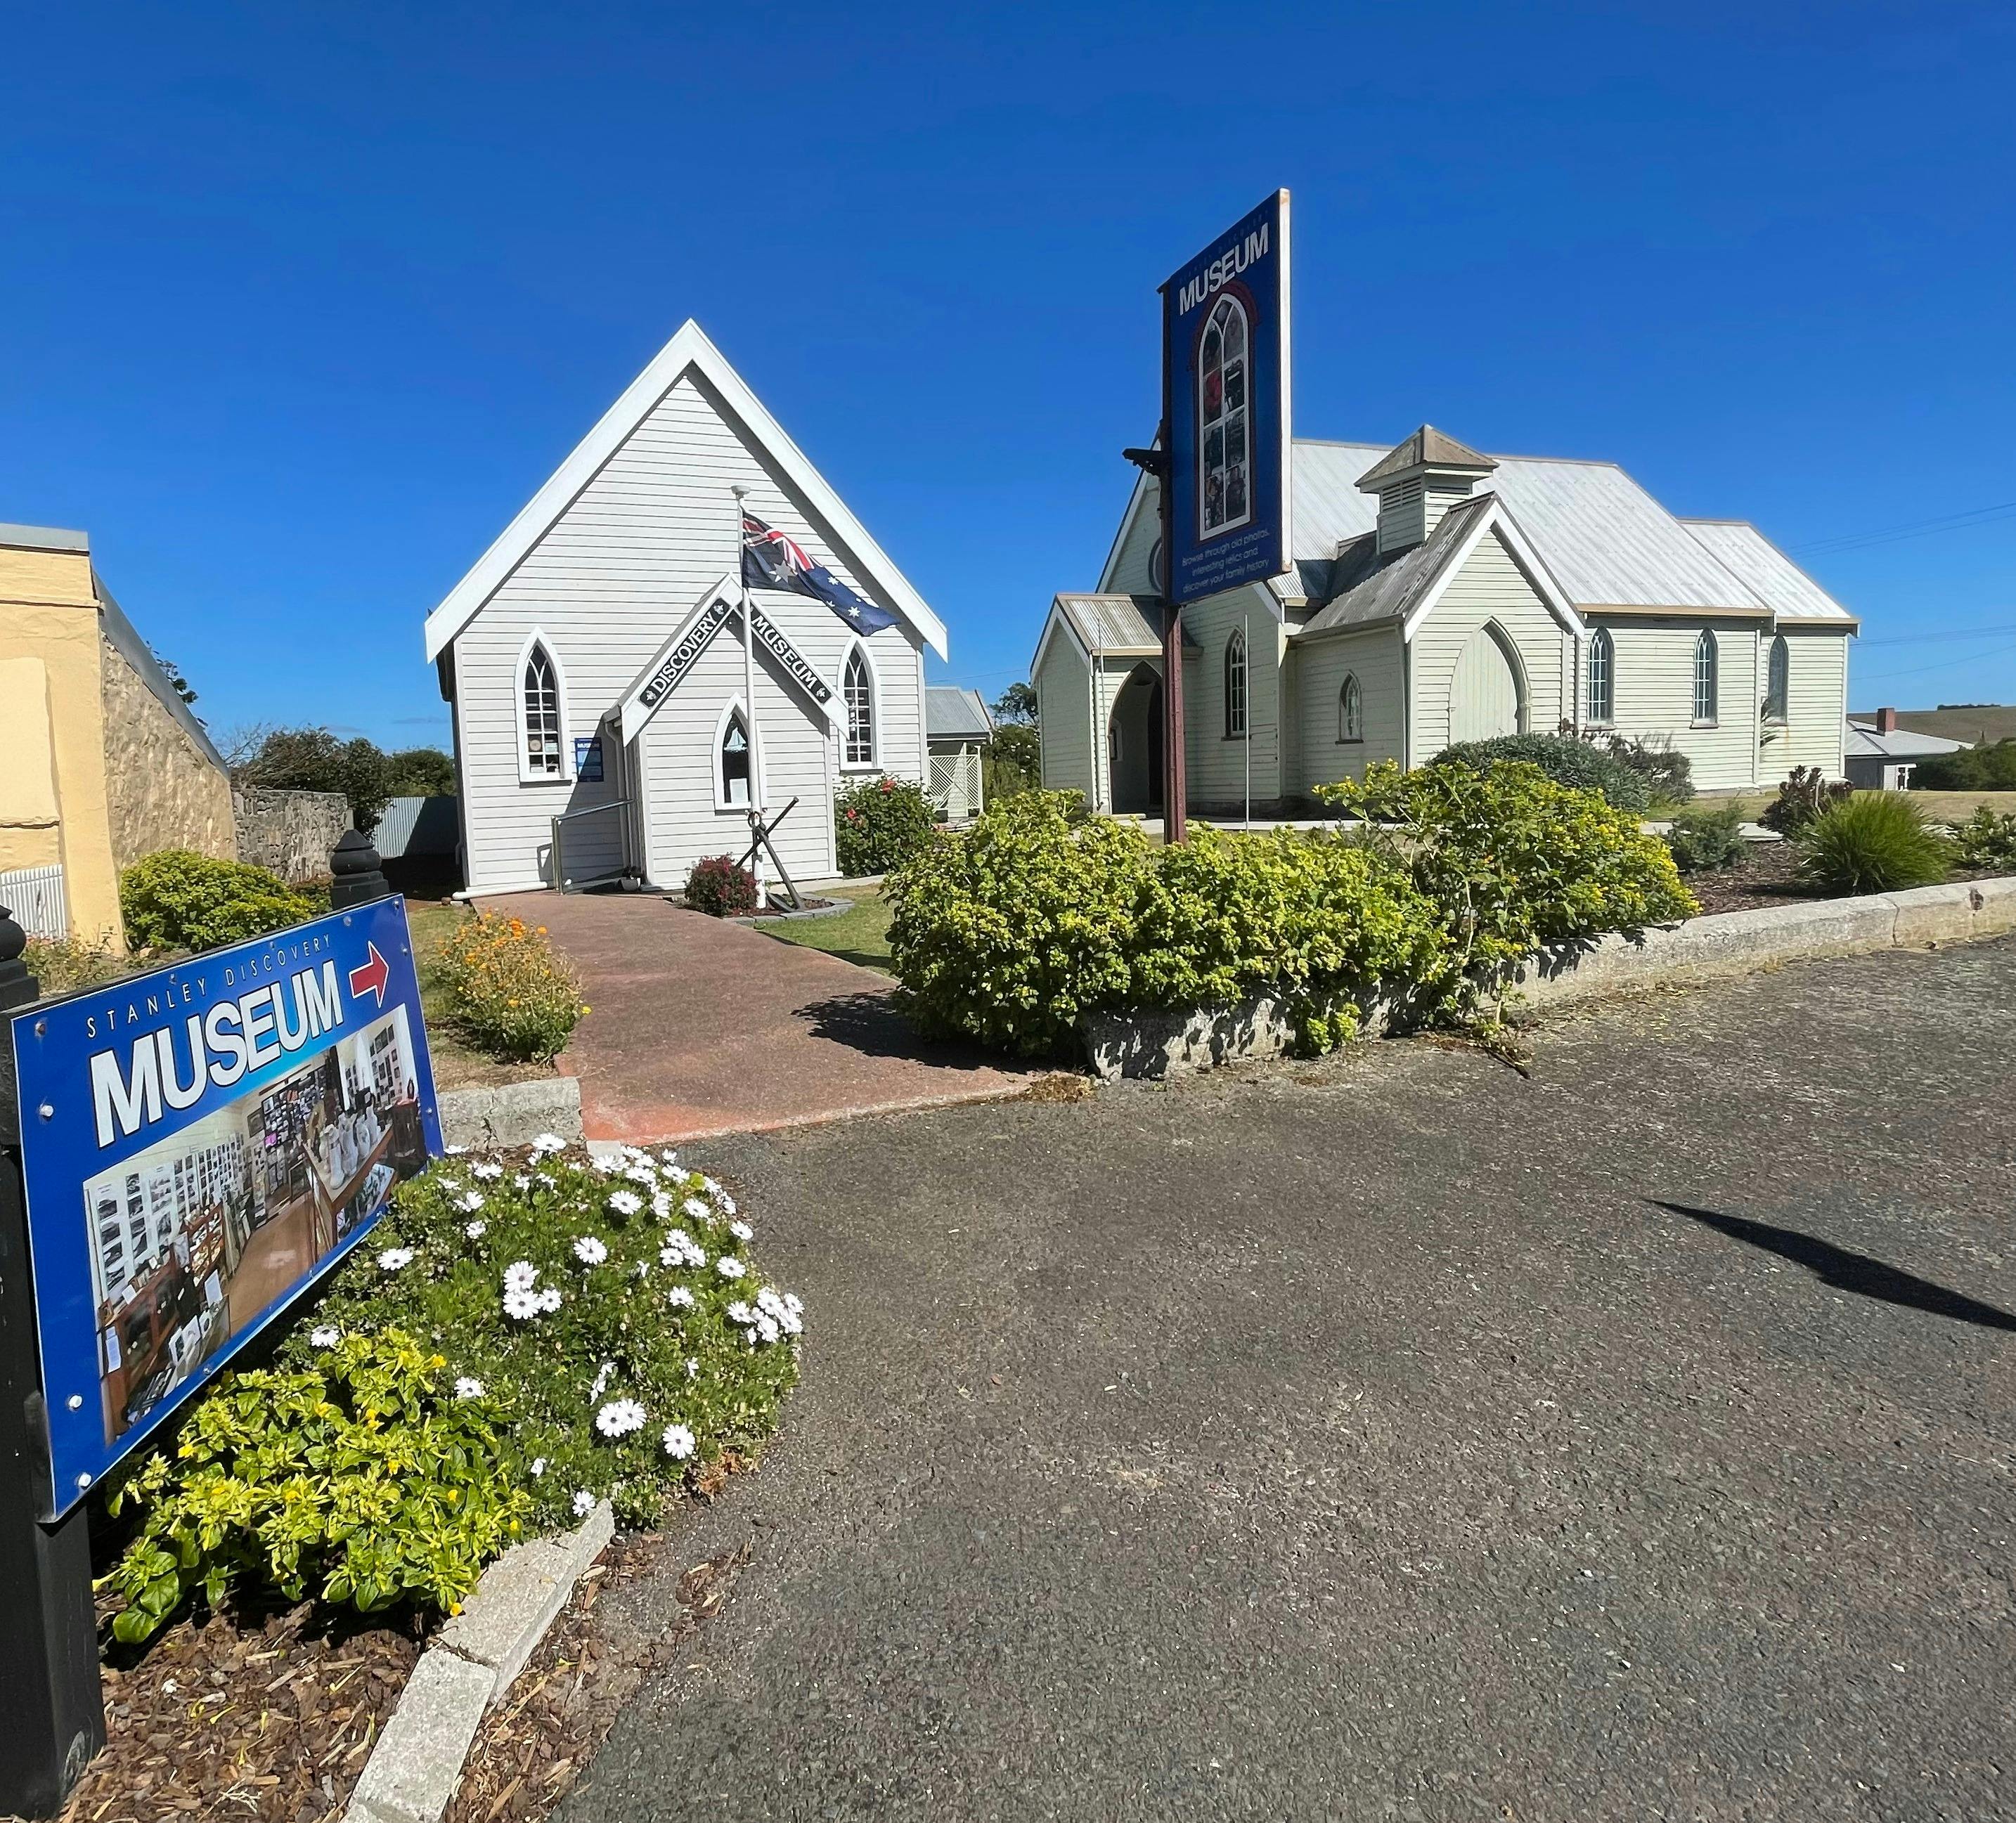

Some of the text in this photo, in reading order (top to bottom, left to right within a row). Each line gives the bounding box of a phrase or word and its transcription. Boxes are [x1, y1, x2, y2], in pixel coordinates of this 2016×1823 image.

[1180, 223, 1269, 316] MUSEUM
[1182, 553, 1204, 566] Browse
[1205, 542, 1230, 558] through
[1232, 536, 1243, 549] old
[1182, 559, 1269, 593] discover your family history
[1192, 546, 1259, 576] interesting relics and
[651, 611, 718, 694] DISCOVERY
[751, 615, 817, 689] MUSEUM
[87, 933, 330, 1038] STANLEY DISCOVERY
[90, 960, 344, 1148] MUSEUM
